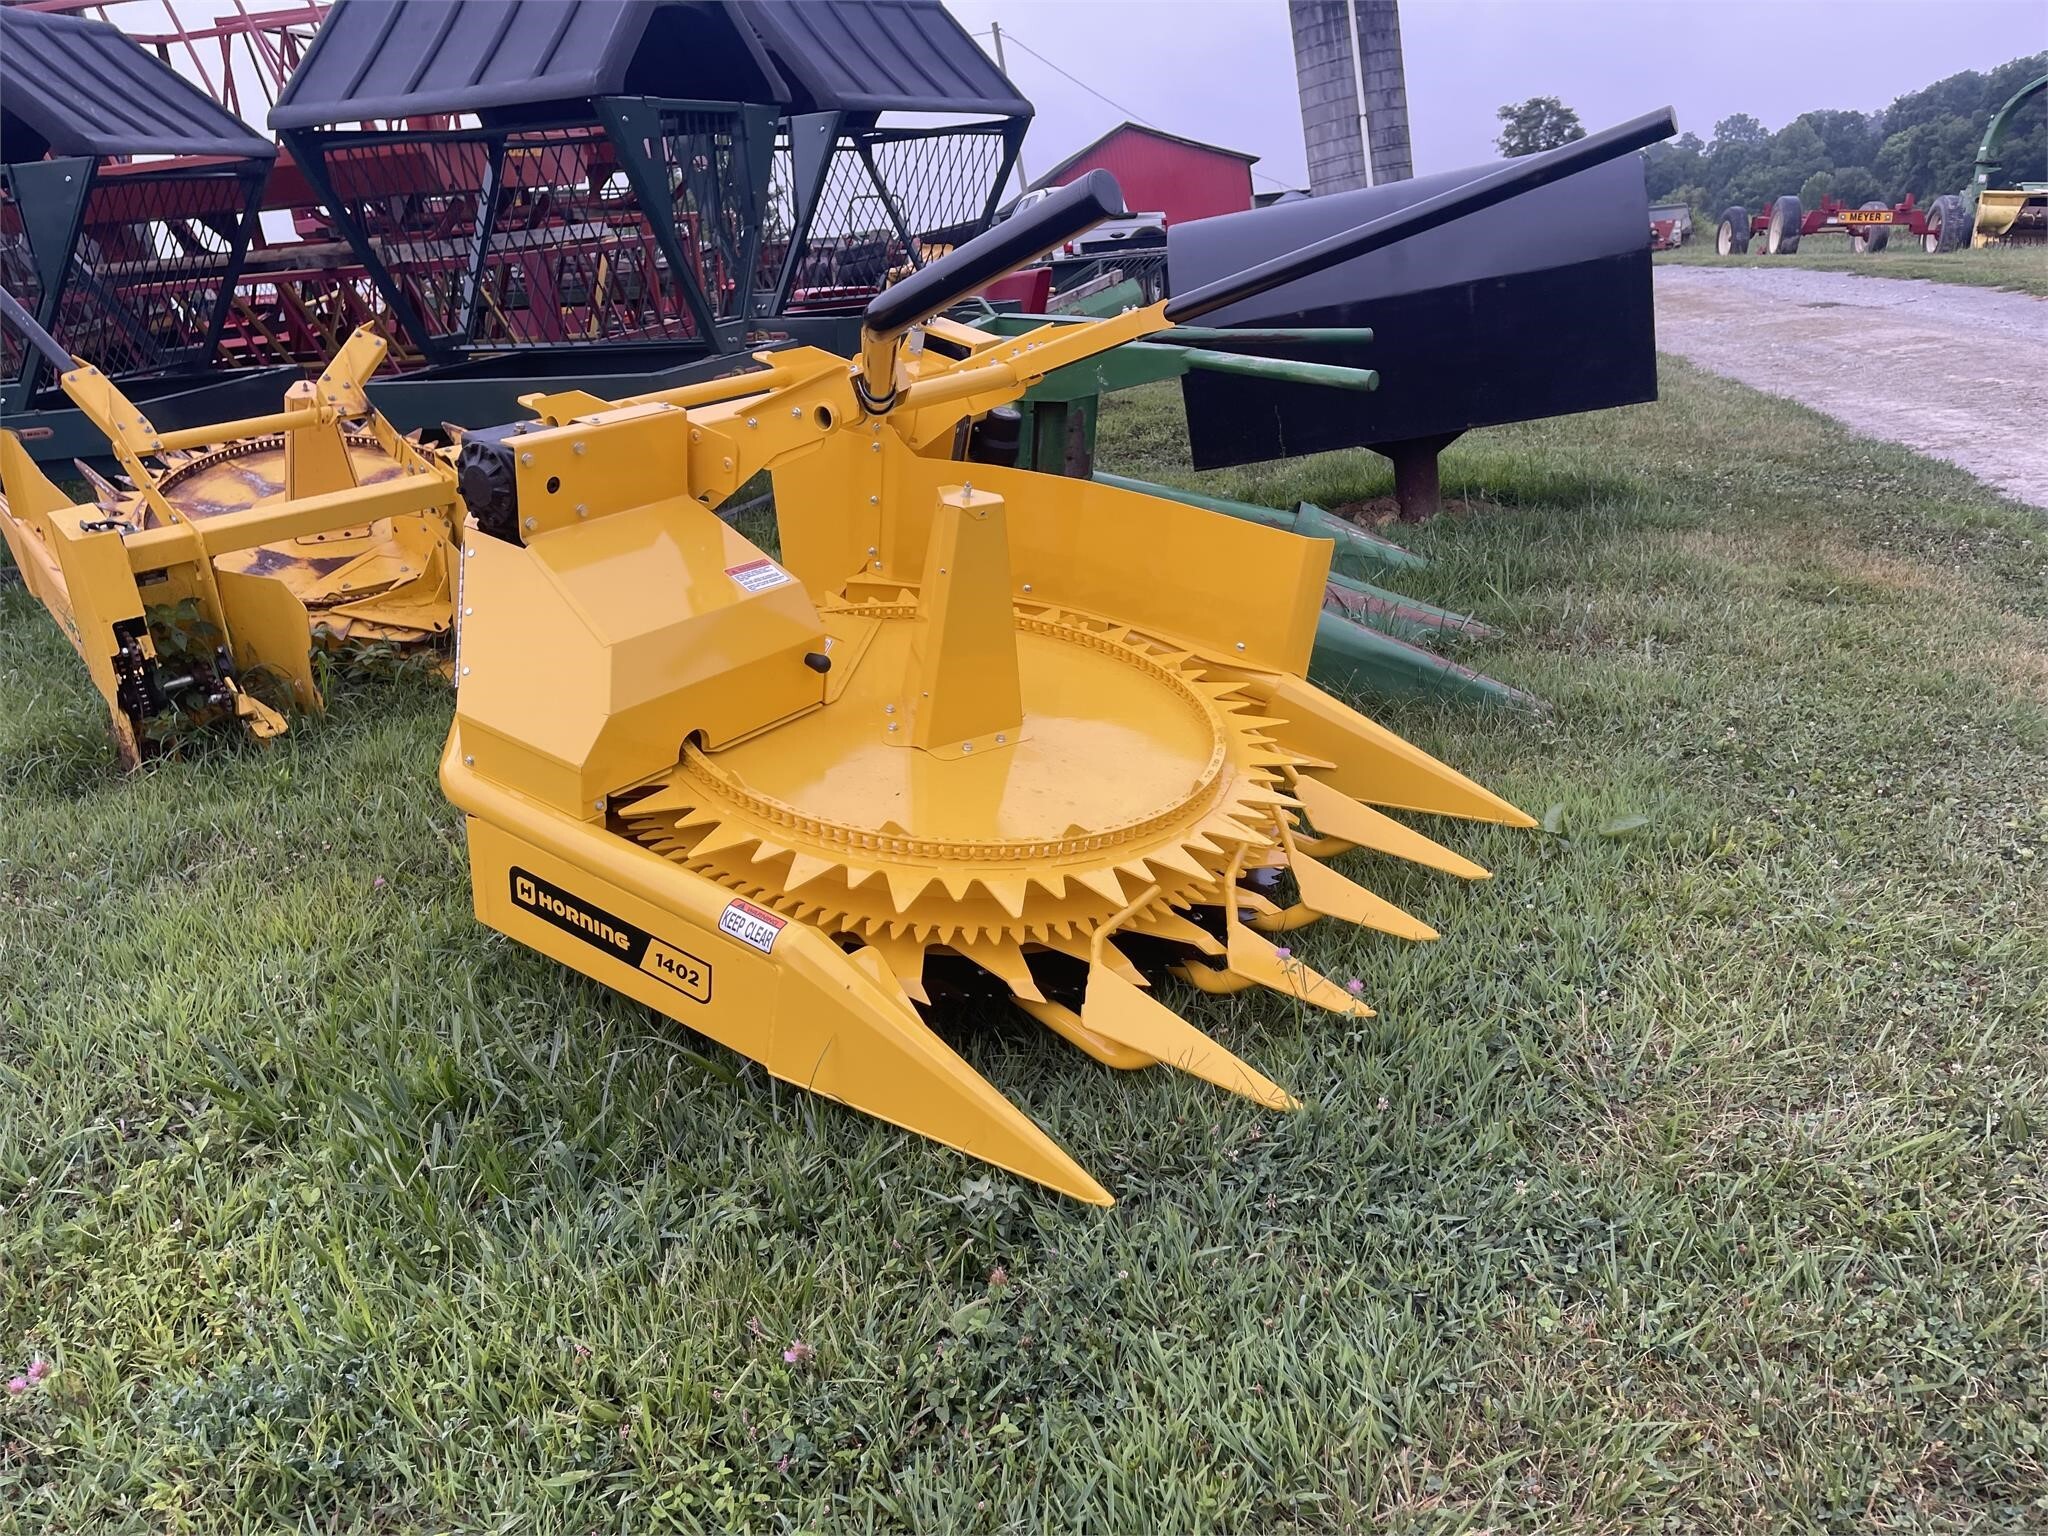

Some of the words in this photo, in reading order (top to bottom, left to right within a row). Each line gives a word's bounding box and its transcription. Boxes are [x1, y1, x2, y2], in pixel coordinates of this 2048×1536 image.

[1849, 212, 1881, 221] MEYER
[539, 891, 630, 951] HORNING
[721, 909, 746, 933] KEEP
[744, 921, 774, 948] CLEAR
[655, 953, 699, 987] 1402
